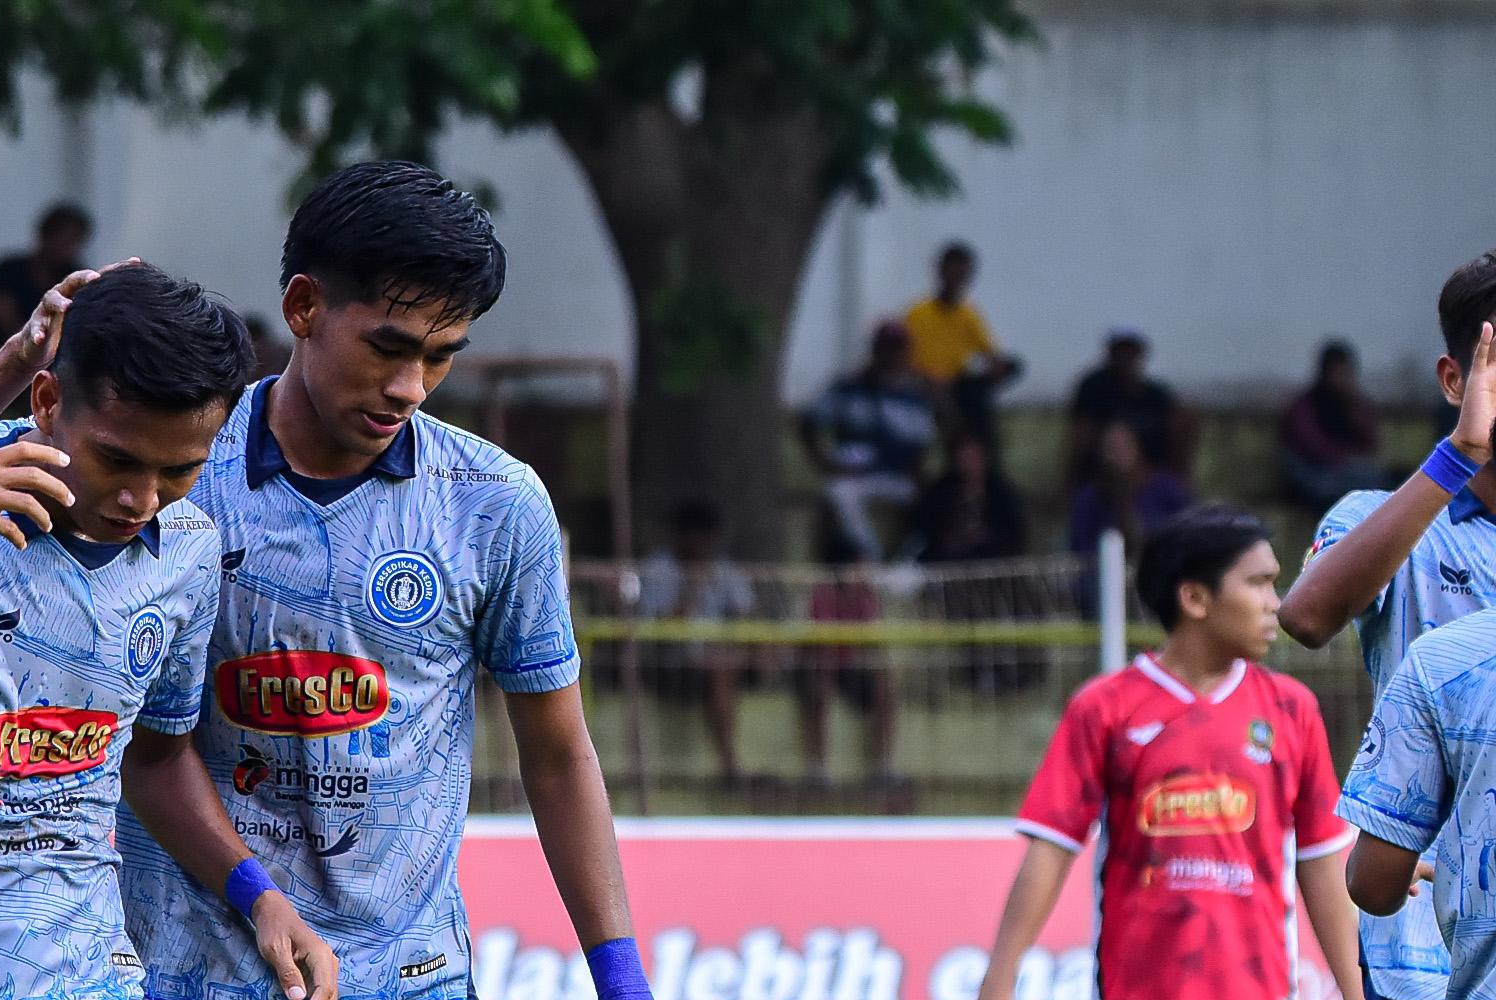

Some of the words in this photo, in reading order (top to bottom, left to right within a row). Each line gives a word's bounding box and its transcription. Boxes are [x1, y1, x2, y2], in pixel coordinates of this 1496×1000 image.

[426, 465, 464, 482] RADAR
[467, 472, 509, 483] KEDIRI
[221, 570, 238, 584] TO
[375, 560, 419, 592] PERSEDIKAB
[419, 568, 433, 601] KEDIRI
[274, 766, 369, 799] mngga
